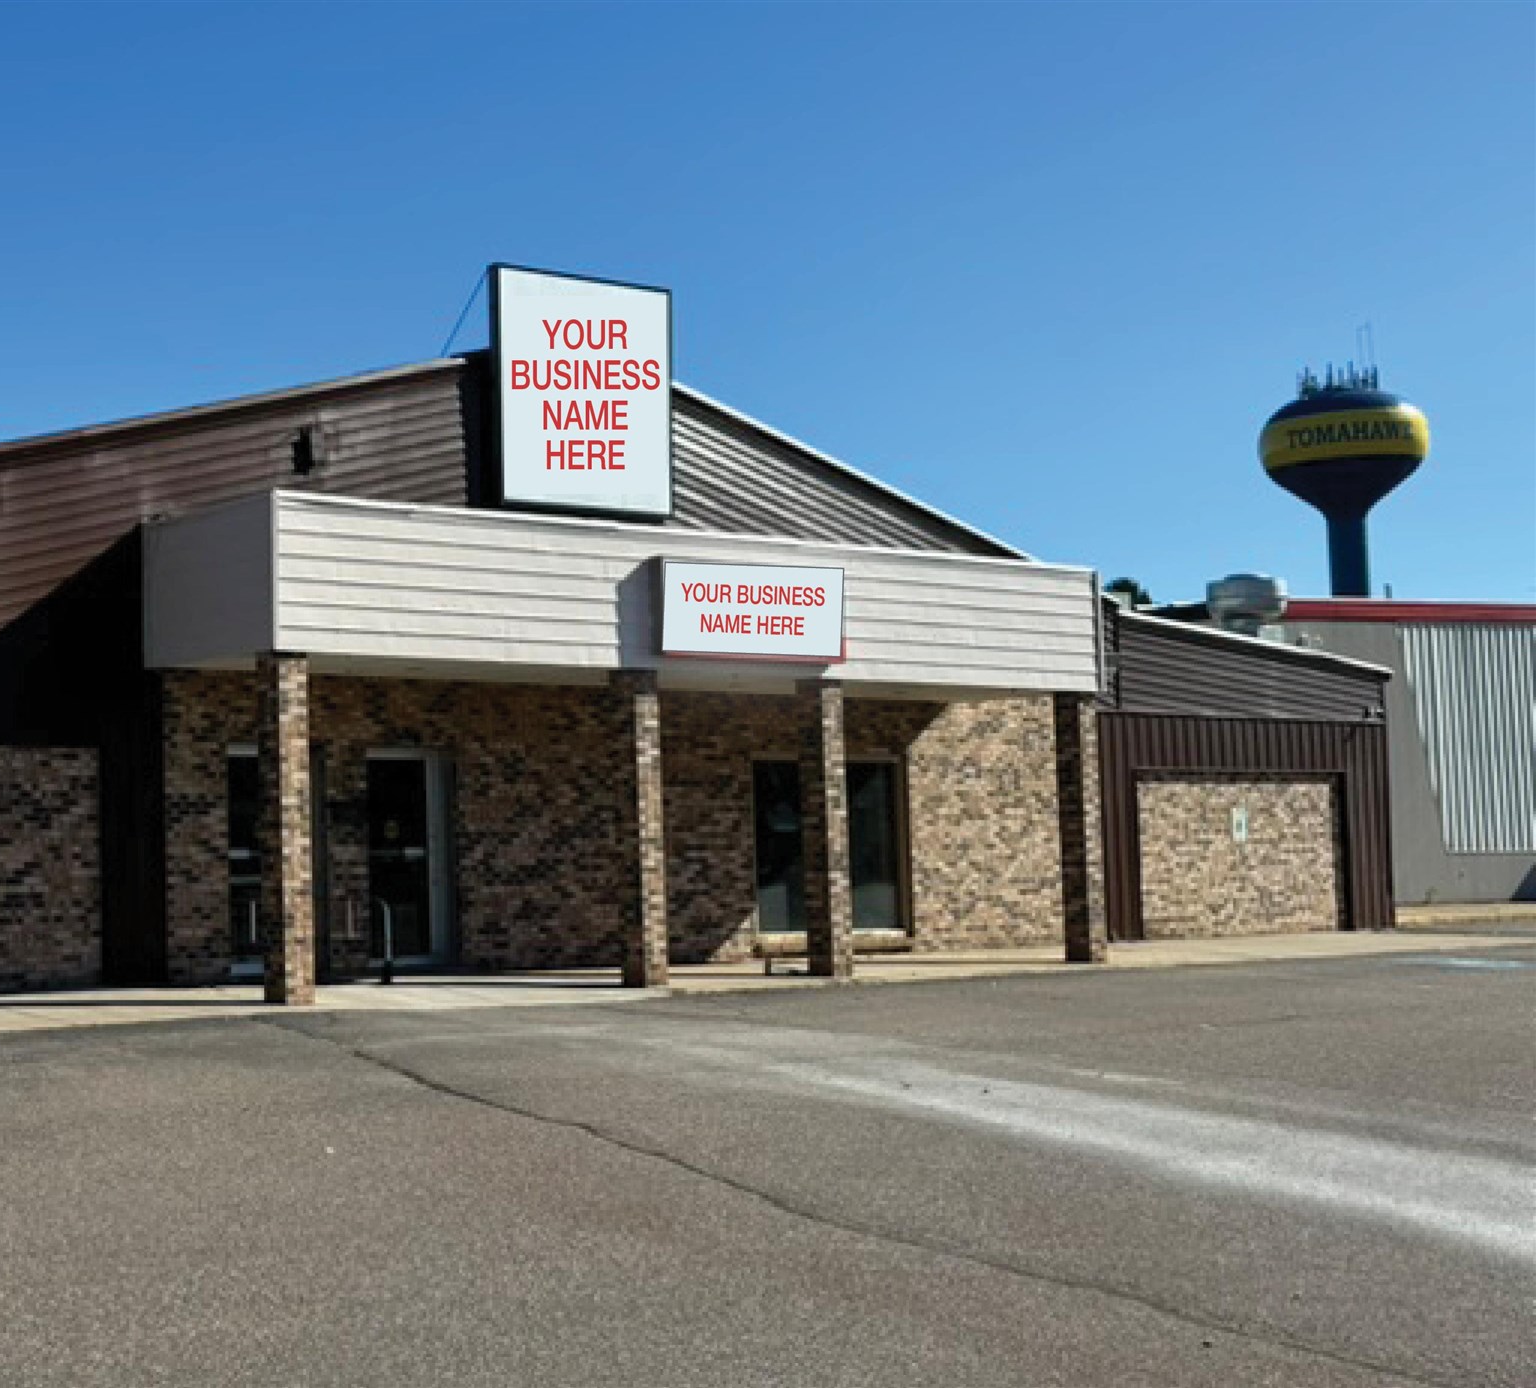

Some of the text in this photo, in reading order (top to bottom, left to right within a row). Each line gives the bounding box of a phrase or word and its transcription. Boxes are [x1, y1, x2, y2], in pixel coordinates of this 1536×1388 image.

[542, 319, 628, 350] YOUR
[511, 359, 661, 391] BUSINESS
[543, 400, 629, 431] NAME
[546, 440, 626, 470] HERE
[681, 582, 825, 607] YOUR BUSINESS
[700, 614, 805, 636] NAME HERE
